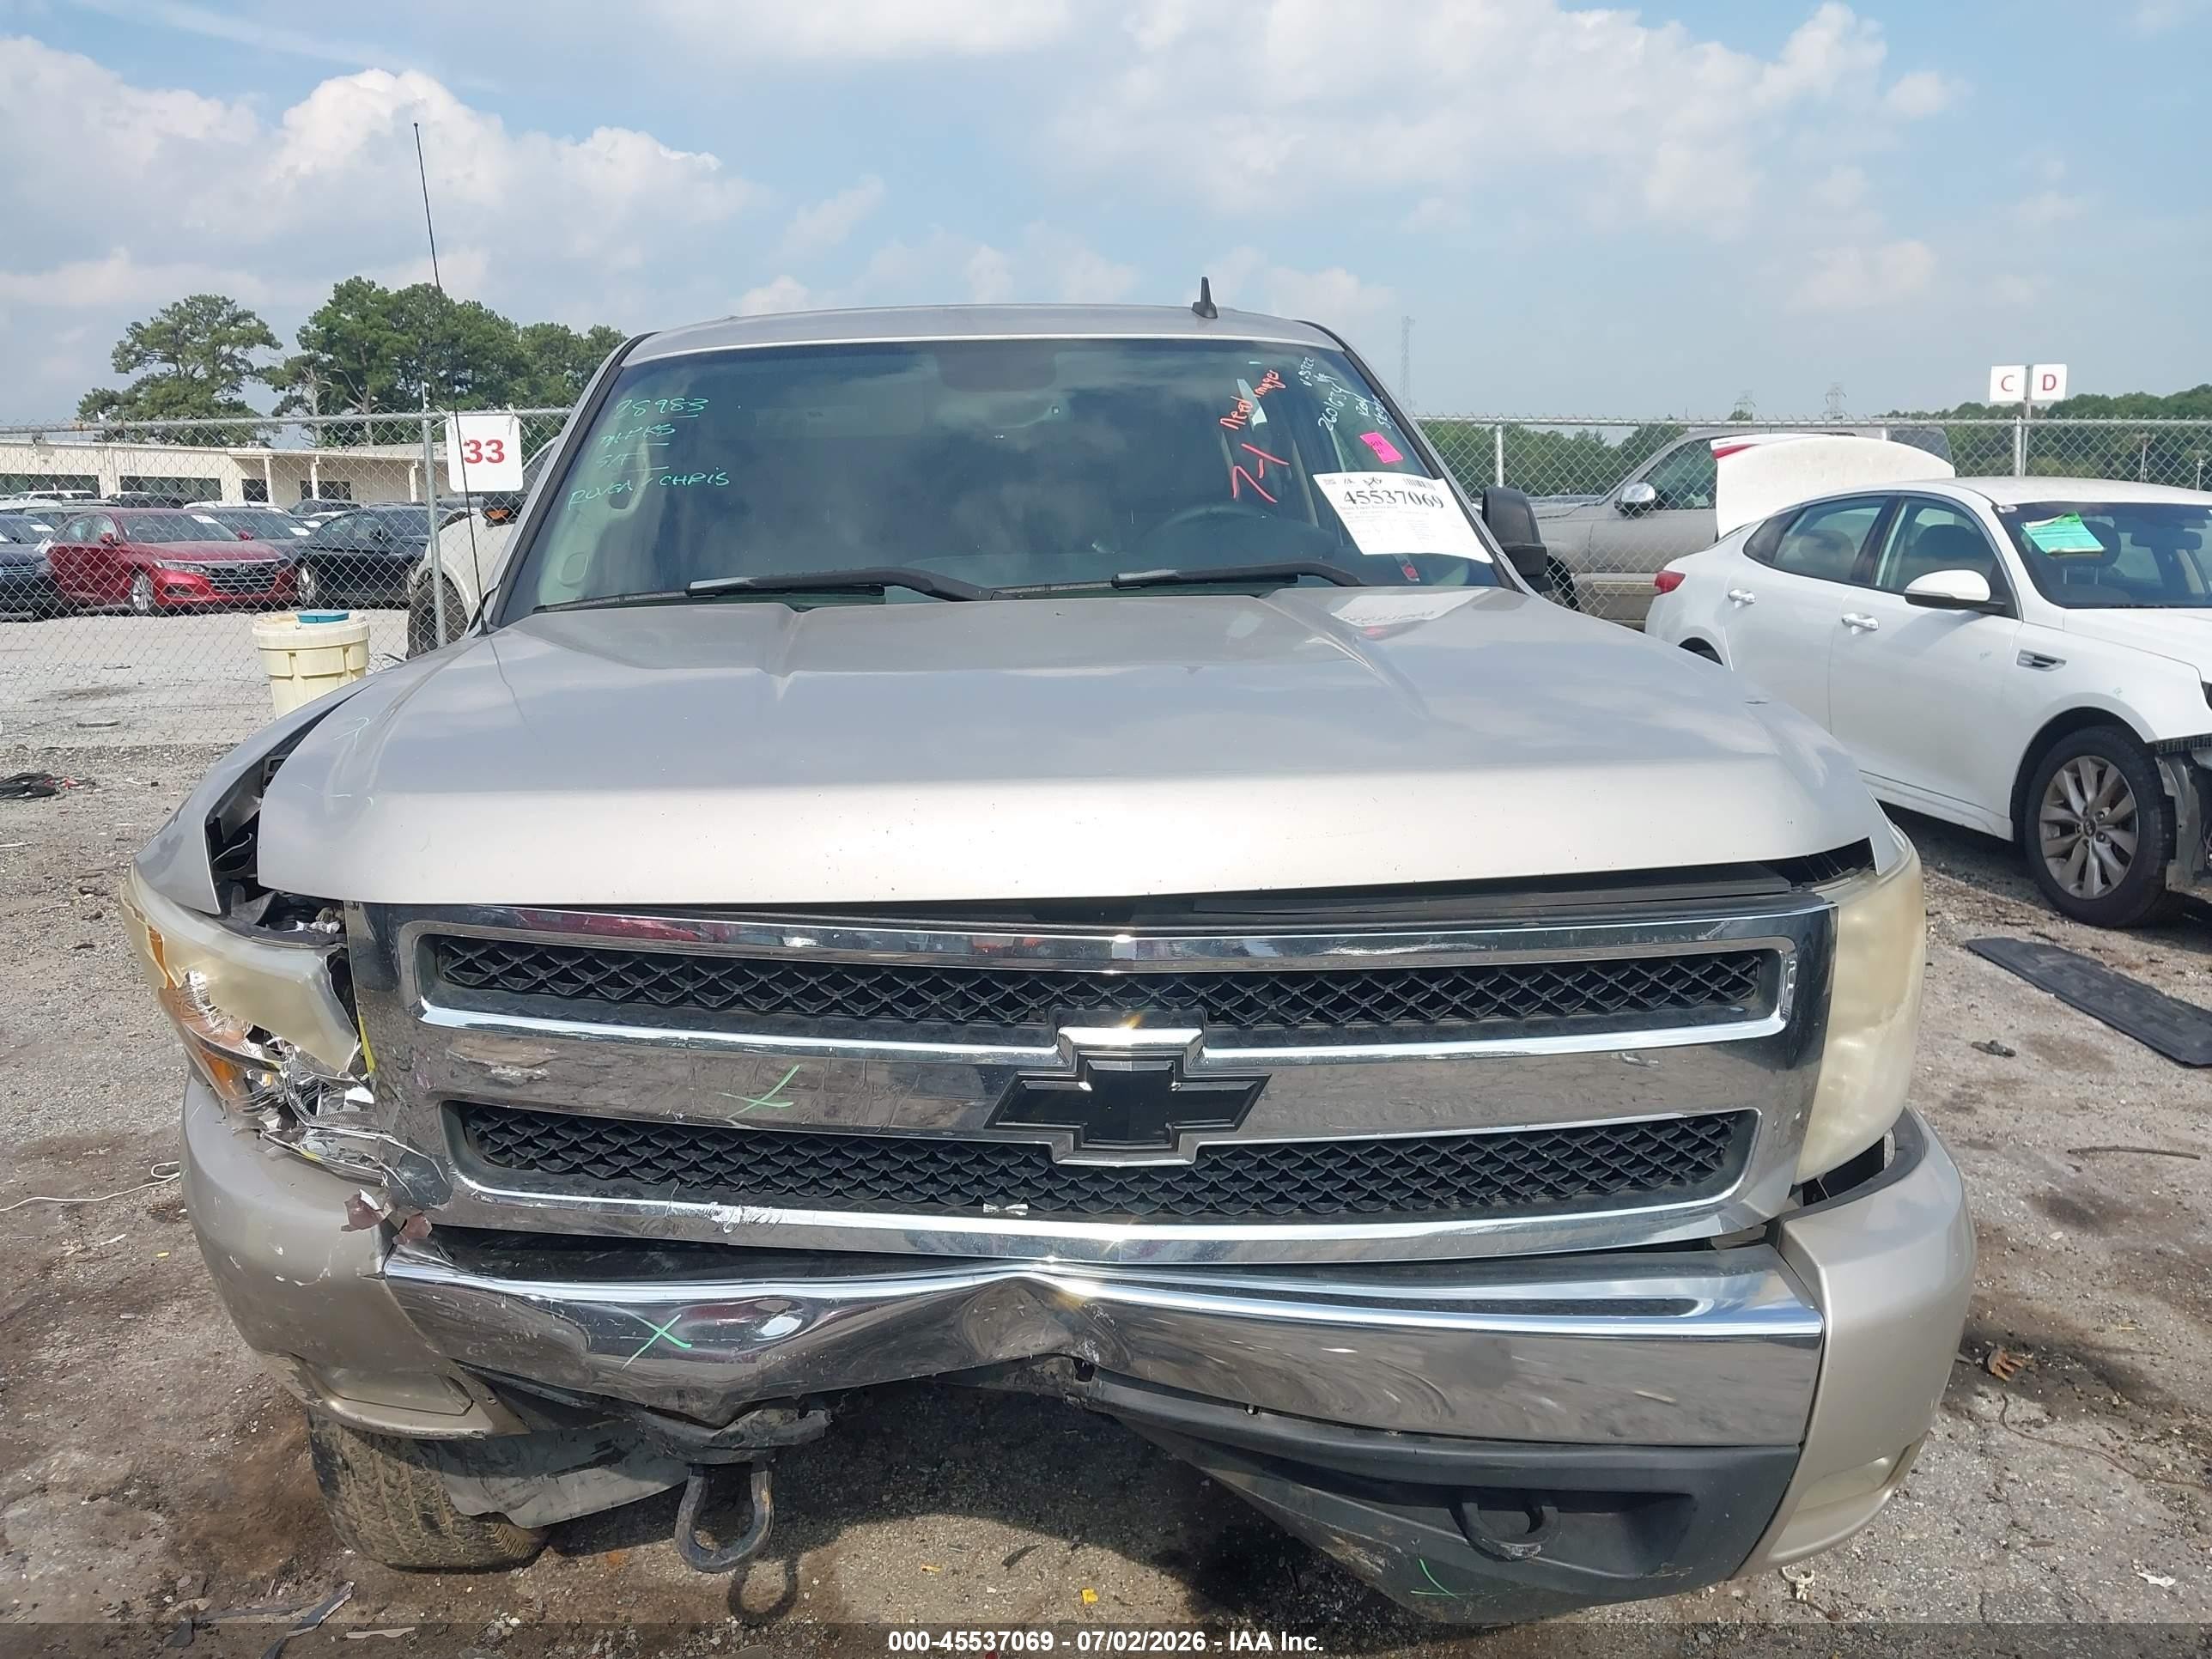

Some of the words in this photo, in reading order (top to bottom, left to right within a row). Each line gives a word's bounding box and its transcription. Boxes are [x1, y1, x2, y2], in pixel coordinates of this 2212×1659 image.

[2000, 374, 2014, 392] C
[2042, 374, 2057, 391] D
[463, 439, 505, 464] 33
[1344, 490, 1444, 508] 45537069
